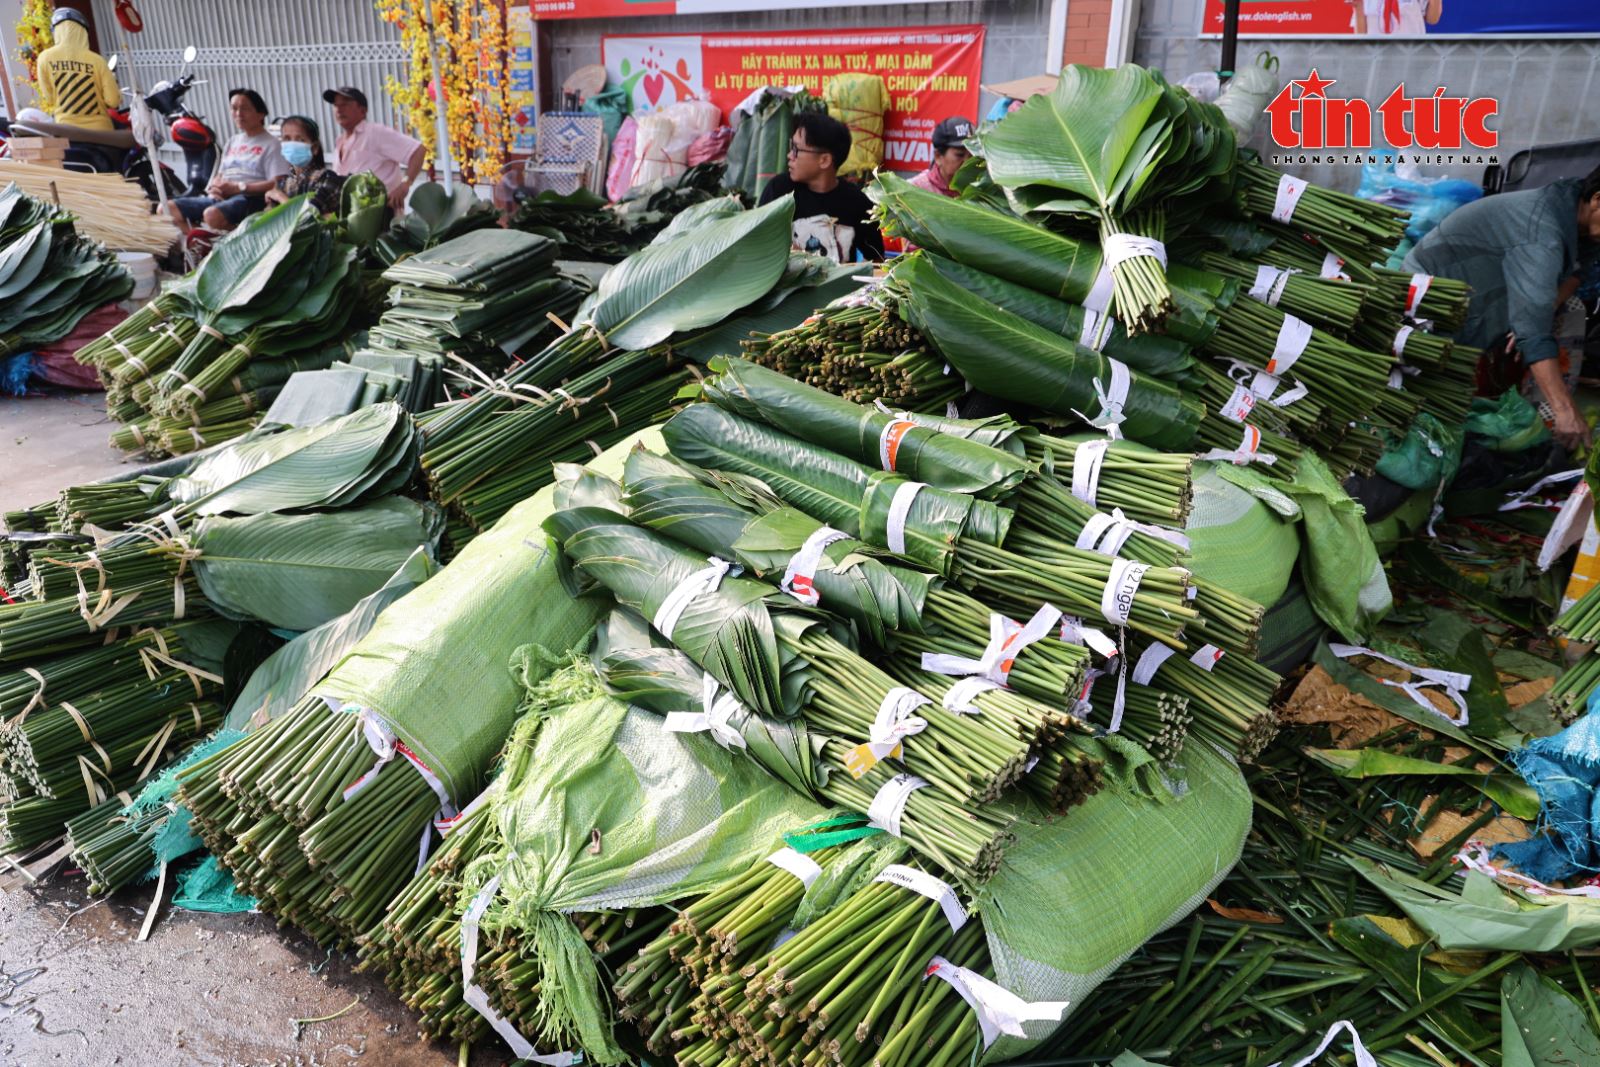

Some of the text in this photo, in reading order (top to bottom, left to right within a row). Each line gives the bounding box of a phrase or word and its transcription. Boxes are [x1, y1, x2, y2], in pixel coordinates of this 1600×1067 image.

[1238, 10, 1312, 23] ww.dolenglish.vn
[48, 60, 94, 75] WHITE
[741, 53, 763, 70] HÃY
[765, 52, 802, 70] TRÁNH
[805, 55, 820, 70] XA
[823, 54, 842, 70] MA
[875, 54, 900, 73] MẠI
[903, 51, 934, 70] DÂM
[714, 72, 728, 89] LÀ
[729, 74, 744, 92] TỰ
[746, 72, 768, 89] BẢO
[887, 72, 928, 91] CHÍNH
[930, 72, 968, 92] MÌNH
[895, 94, 919, 116] HỘI
